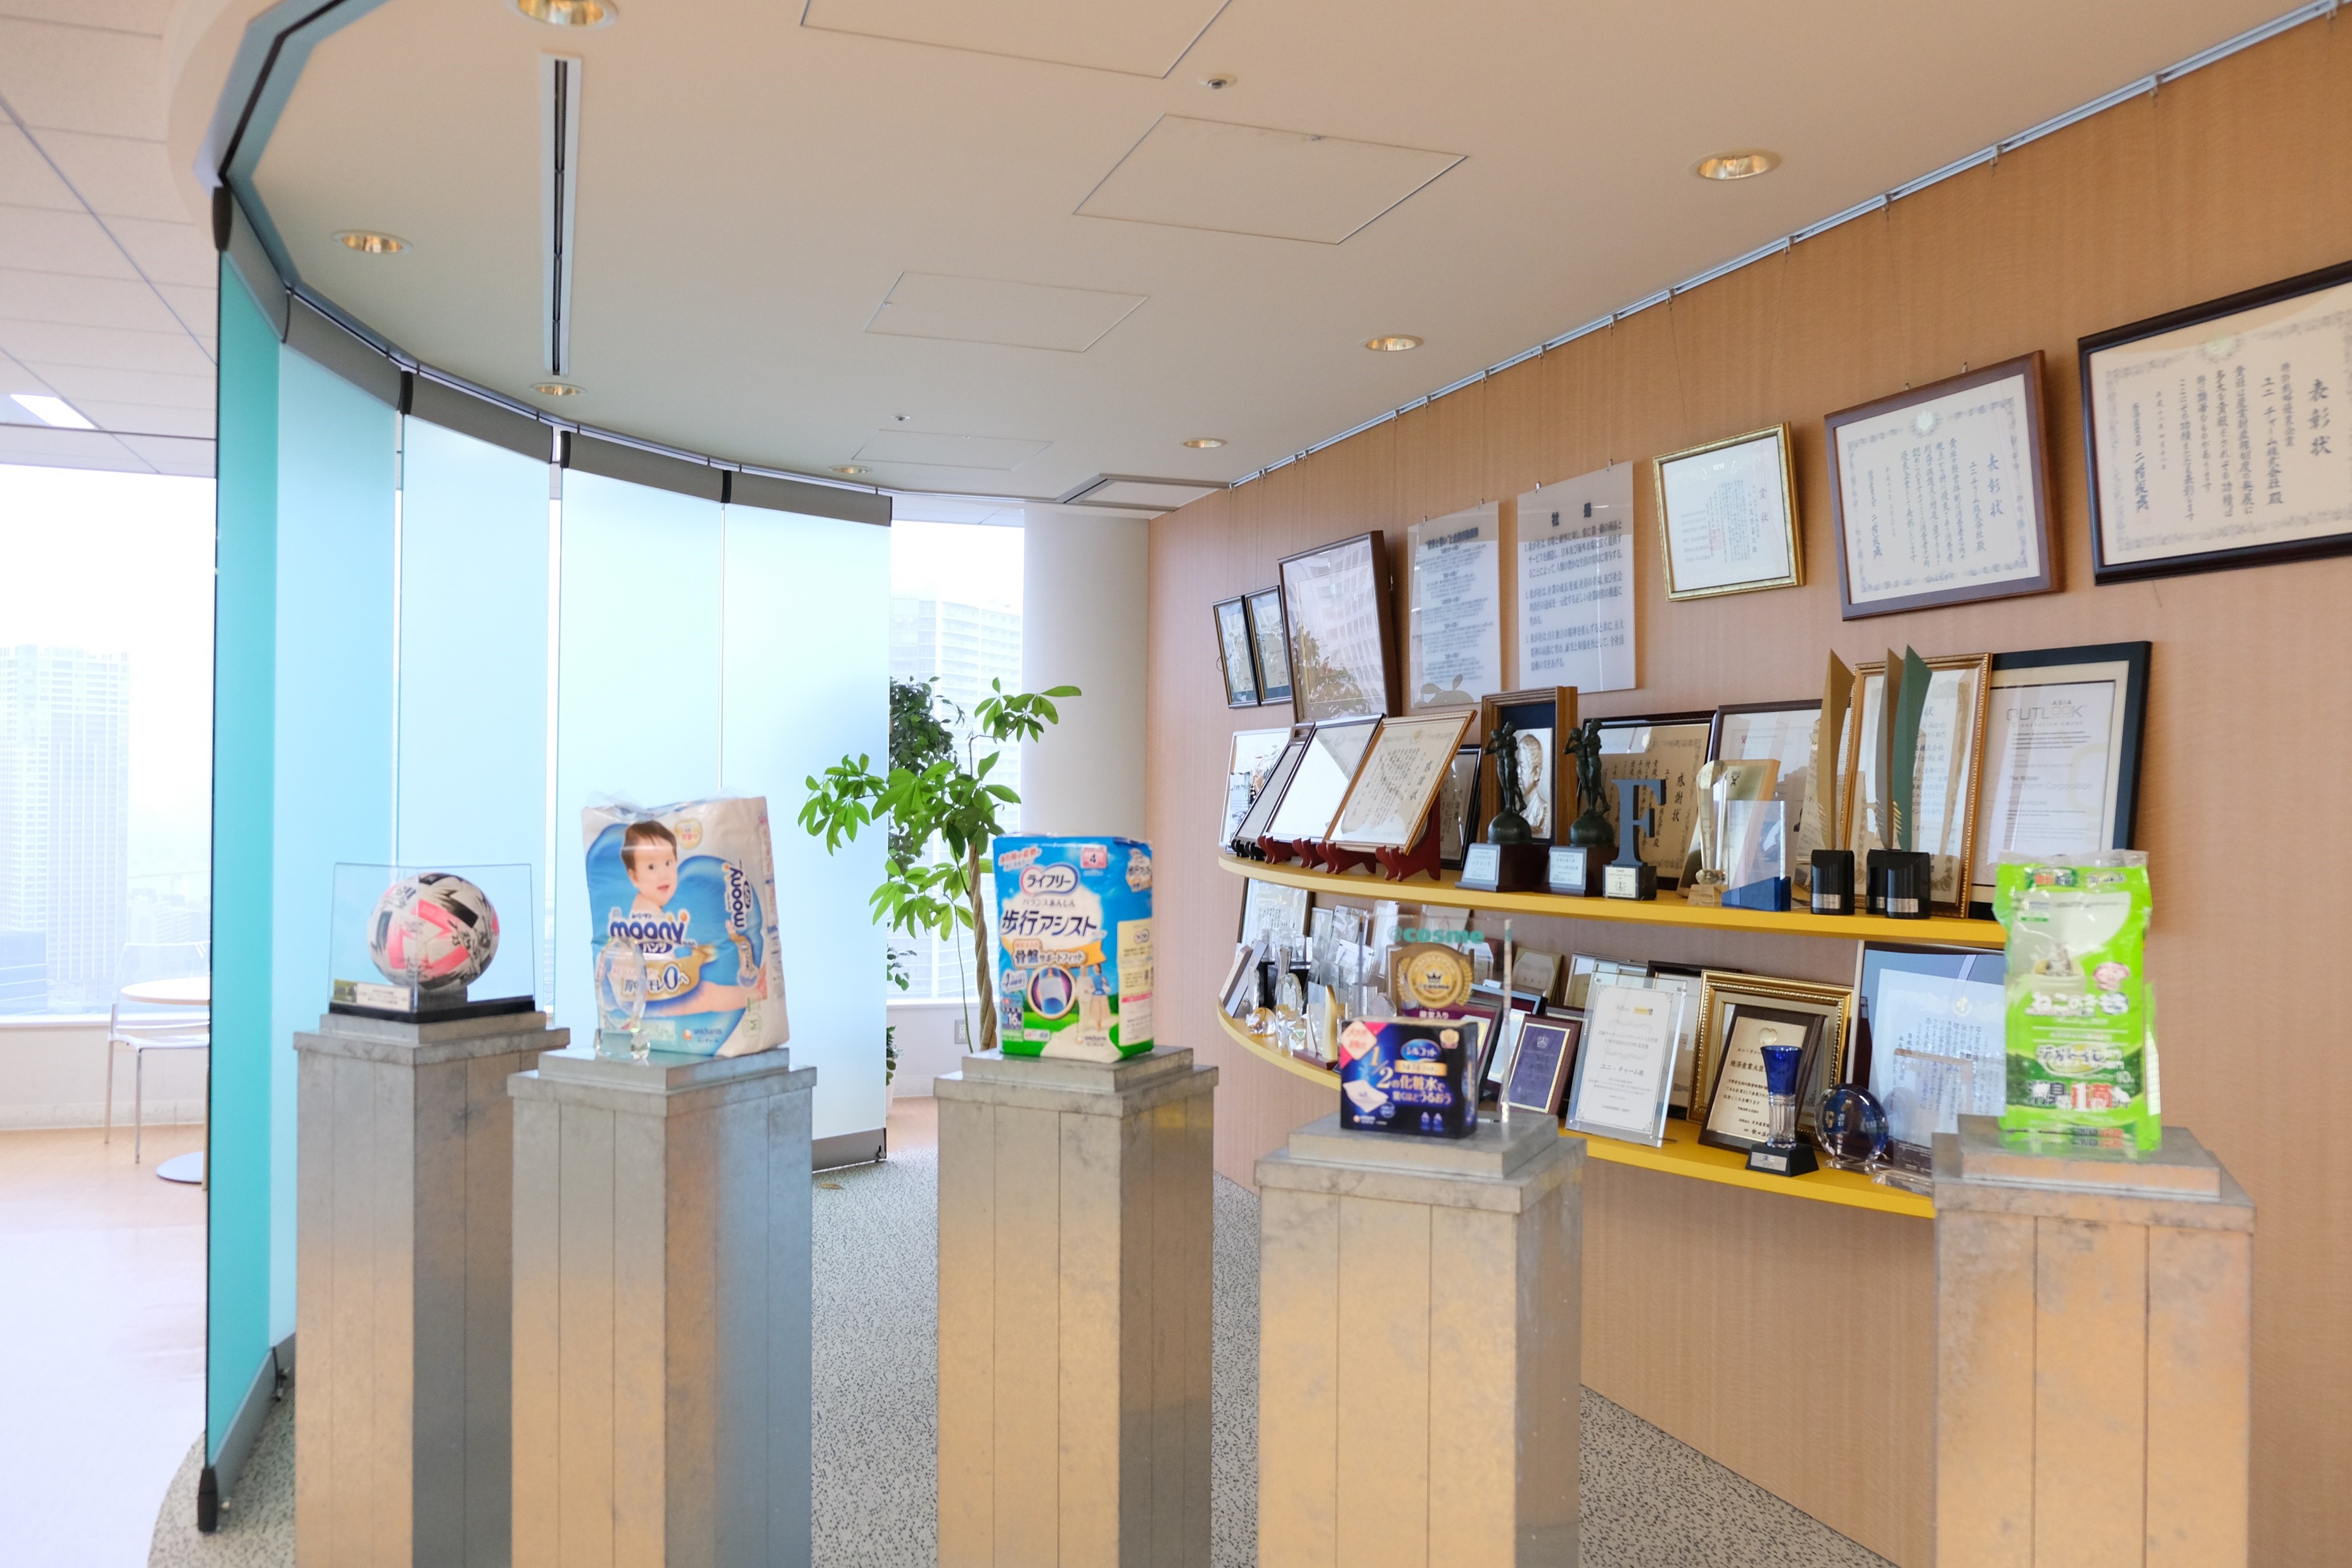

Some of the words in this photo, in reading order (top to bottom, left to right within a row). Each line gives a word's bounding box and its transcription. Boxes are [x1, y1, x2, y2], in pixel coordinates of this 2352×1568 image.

[2308, 379, 2332, 456] 表彰状
[1987, 453, 2004, 517] 表彰状
[1758, 487, 1769, 523] 賞状
[1671, 771, 1685, 822] 感謝状
[1027, 874, 1071, 888] ライフリー
[730, 867, 745, 928] moony
[1022, 898, 1075, 908] バランスあんしん
[610, 922, 684, 944] moony
[1000, 909, 1097, 937] 歩行アシスト
[1015, 949, 1083, 964] 骨盤サポートフィット
[1405, 1046, 1438, 1057] シルコット
[1730, 1060, 1766, 1073] 経済産業大臣
